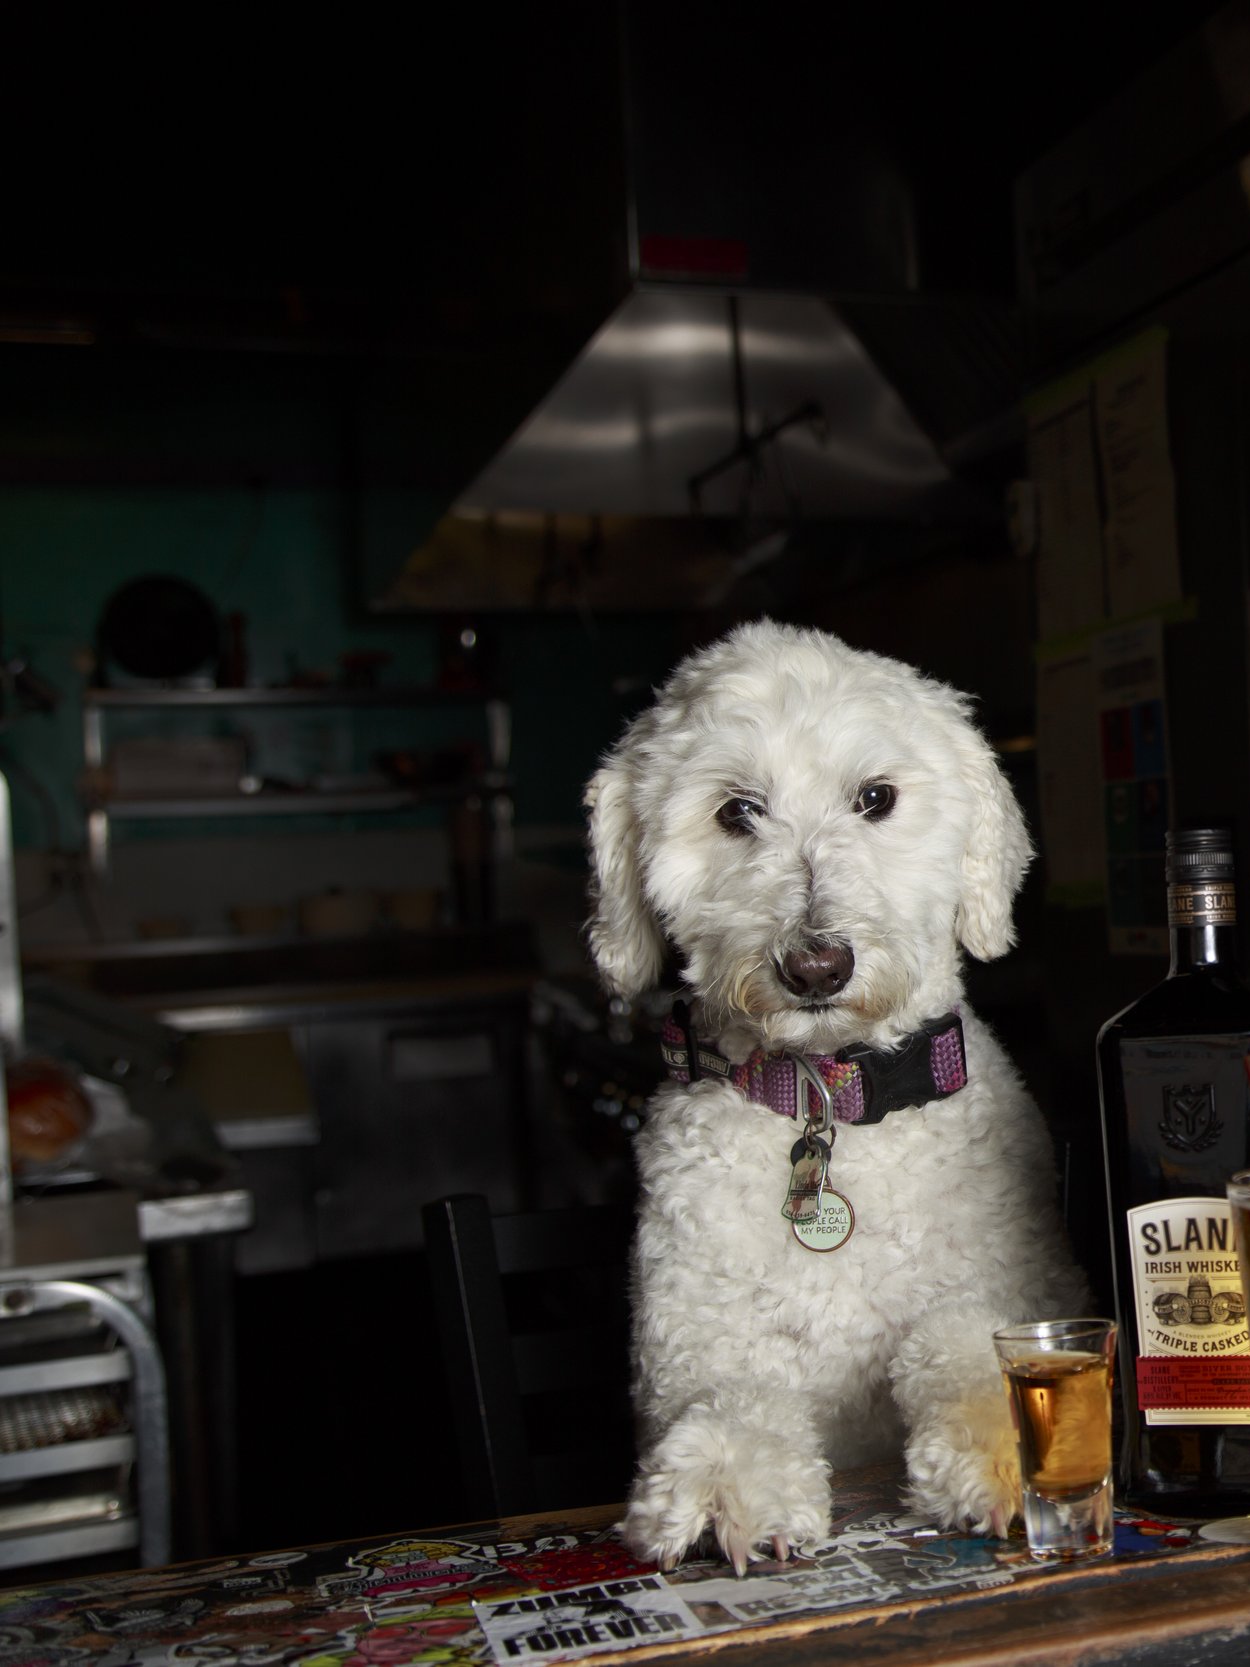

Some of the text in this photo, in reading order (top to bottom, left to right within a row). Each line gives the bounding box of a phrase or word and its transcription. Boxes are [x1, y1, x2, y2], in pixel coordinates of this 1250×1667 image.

[823, 1207, 846, 1215] YOUR
[798, 1216, 848, 1225] EOPLE CALL
[801, 1226, 846, 1235] MY PEOPLE
[1141, 1217, 1237, 1256] SLAN
[1145, 1262, 1182, 1274] IRISH
[1155, 1331, 1250, 1352] TRIPLE CASKED
[502, 1613, 688, 1657] FOREVER
